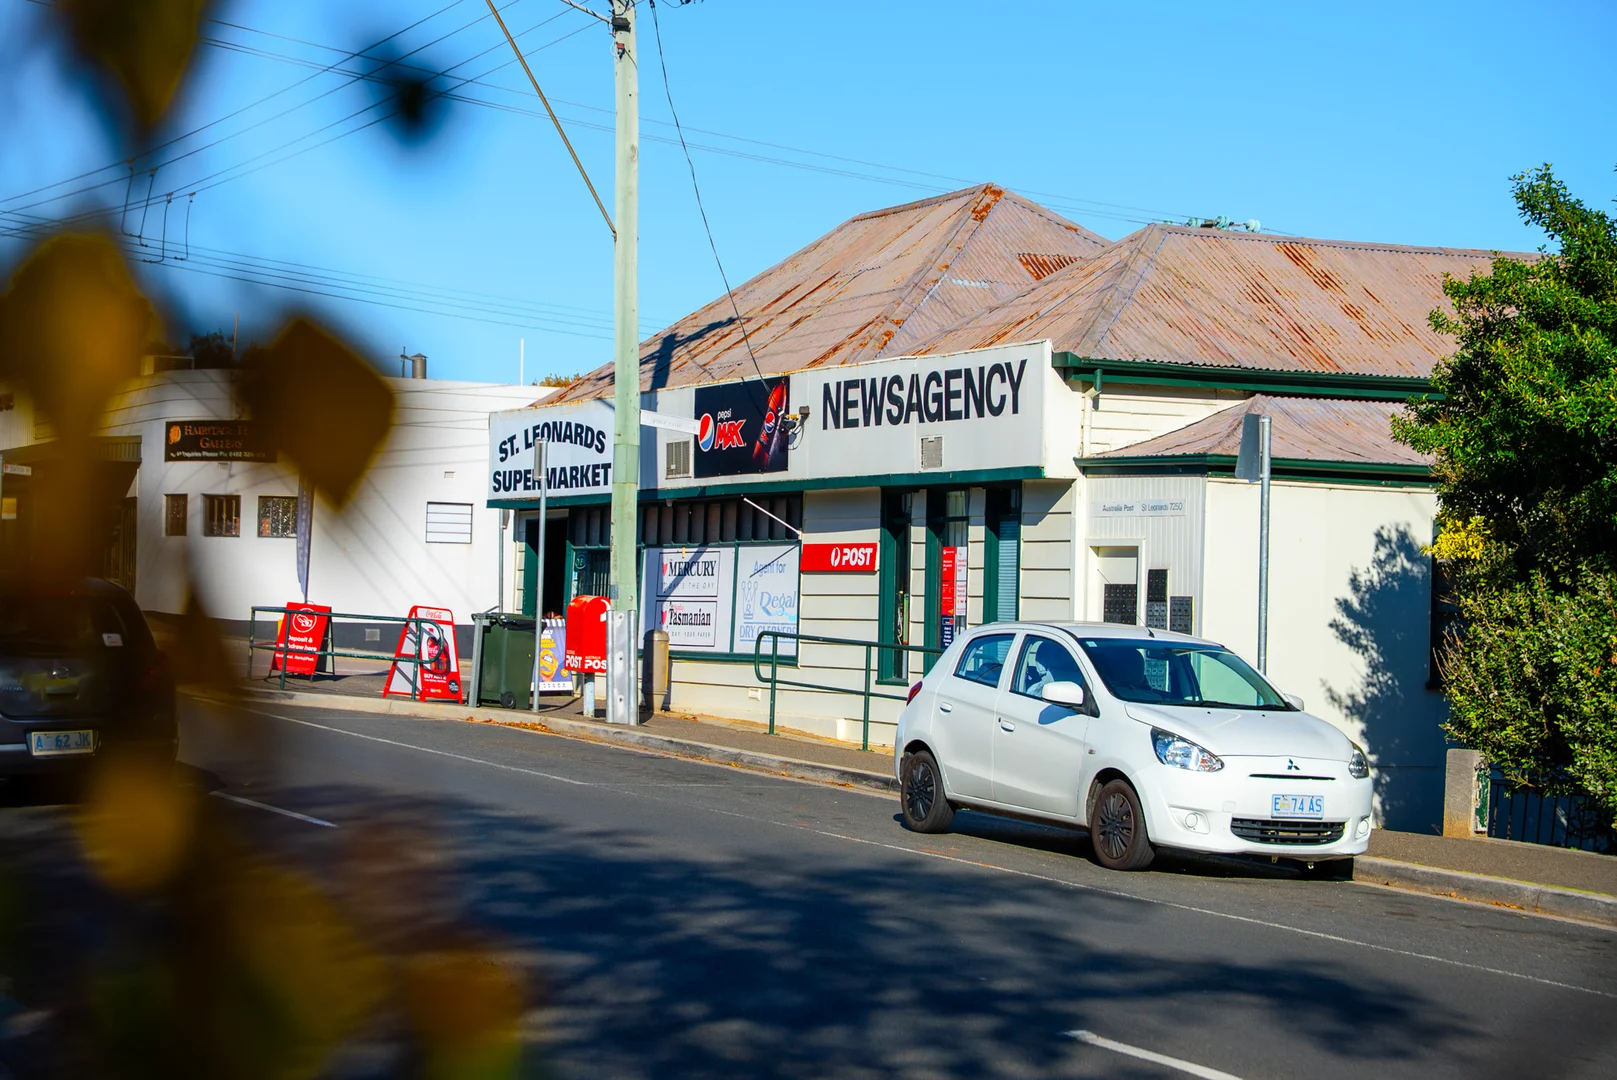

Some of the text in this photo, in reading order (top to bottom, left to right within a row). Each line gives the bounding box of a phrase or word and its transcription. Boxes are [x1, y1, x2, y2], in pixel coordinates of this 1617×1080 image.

[822, 359, 1028, 430] NEWSAGENCY
[717, 408, 732, 421] pepsi
[498, 420, 607, 463] ST. LEONARDS
[714, 419, 747, 450] MAX
[1102, 504, 1135, 512] Australia Post
[1147, 503, 1169, 512] Leonards
[1169, 502, 1183, 511] 7250
[841, 548, 874, 566] POST
[668, 560, 717, 577] MERCURY
[753, 561, 787, 577] Agent for
[759, 591, 797, 617] Regal
[668, 608, 712, 627] Tasmanian
[739, 625, 755, 639] DRY
[565, 655, 583, 669] POST
[584, 659, 607, 670] POS
[36, 733, 91, 748] A 62 JK
[1274, 797, 1322, 812] E 74 AS
